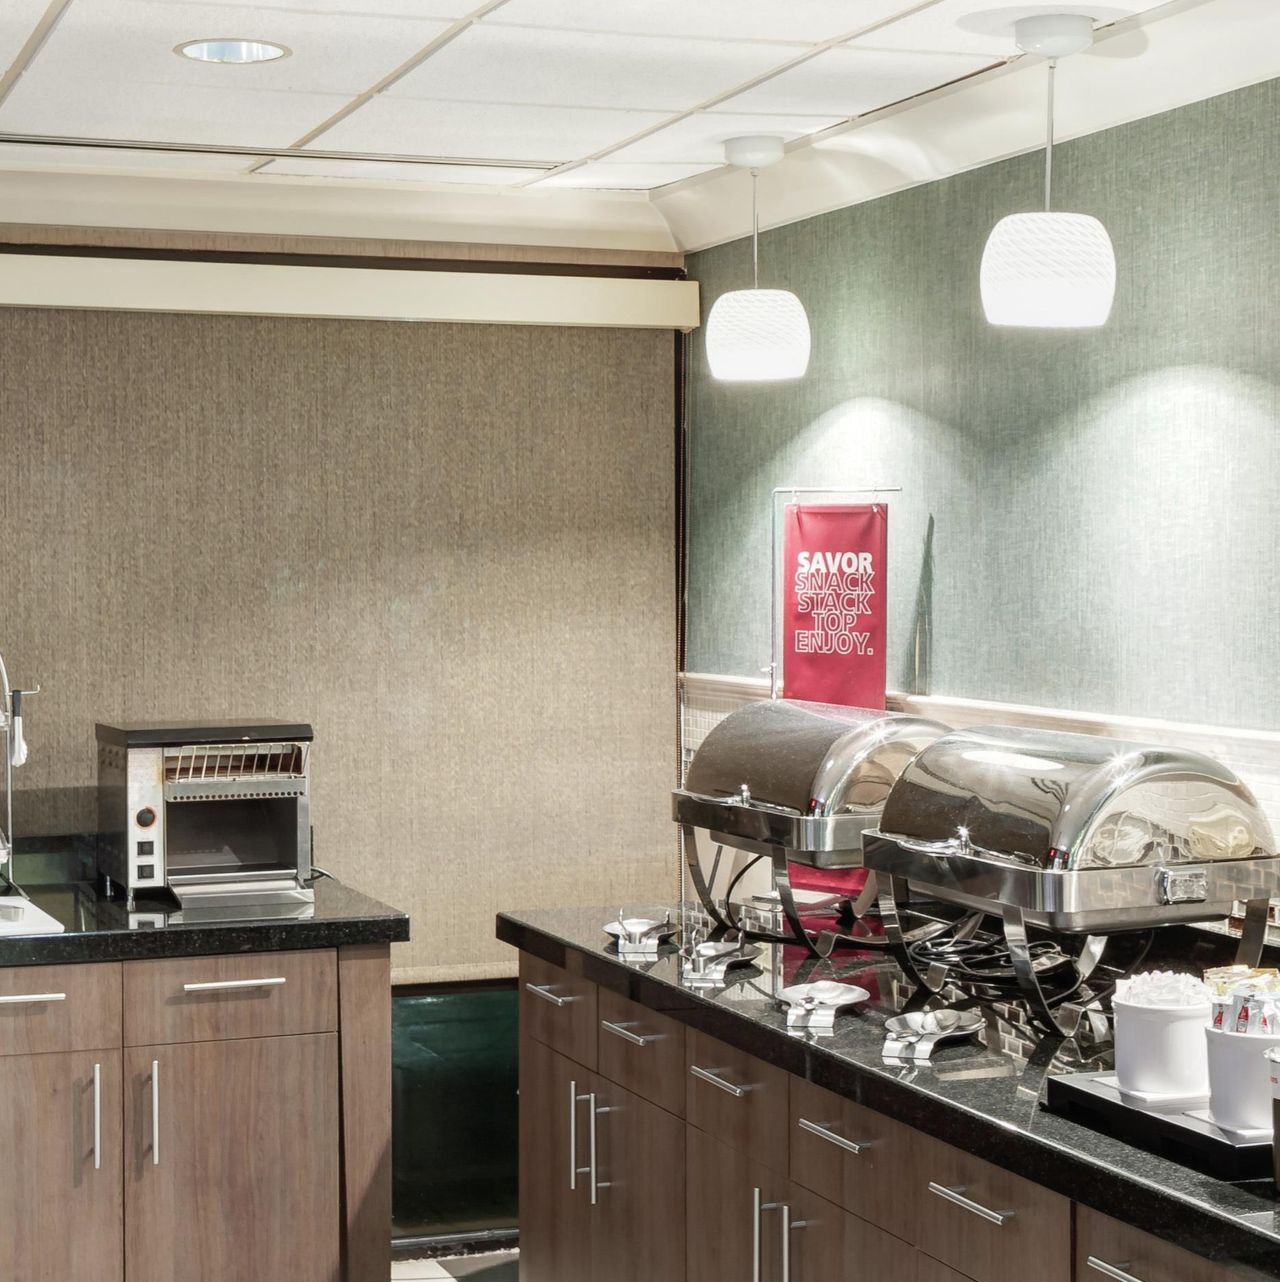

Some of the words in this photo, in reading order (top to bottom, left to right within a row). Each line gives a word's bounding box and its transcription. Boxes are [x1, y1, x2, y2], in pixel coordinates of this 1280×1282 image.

[797, 551, 873, 573] SAVOR
[795, 571, 875, 594] SNACK
[797, 591, 872, 614] STACK
[812, 611, 857, 634] TOP
[795, 630, 874, 655] ENJOY.
